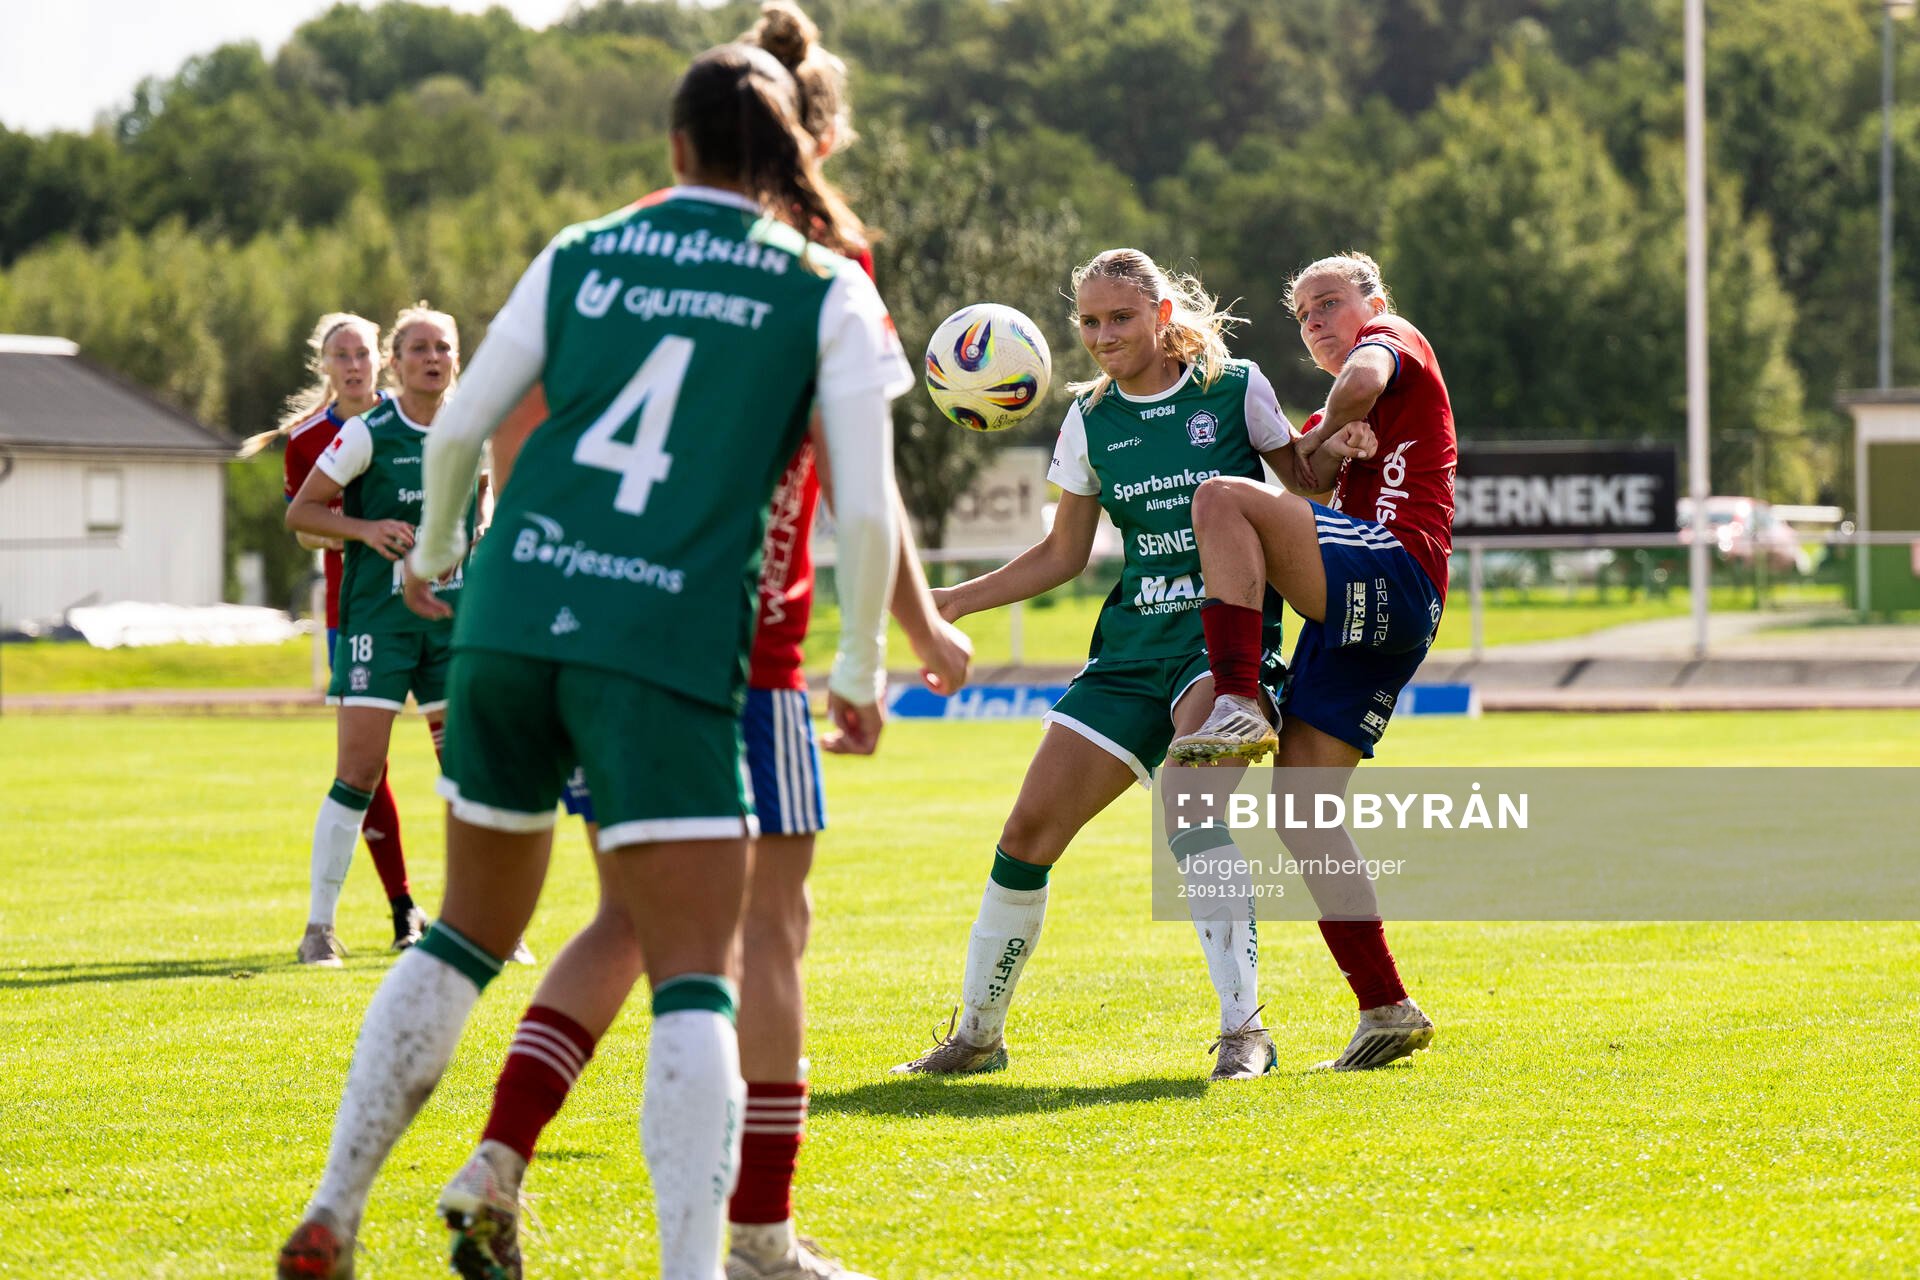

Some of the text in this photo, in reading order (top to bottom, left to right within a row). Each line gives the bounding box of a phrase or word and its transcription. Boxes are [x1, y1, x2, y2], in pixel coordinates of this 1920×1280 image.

[572, 334, 696, 517] 4
[1140, 405, 1176, 420] TIFOSI
[1107, 438, 1134, 452] CRAFT
[1114, 468, 1221, 501] Sparbanken
[1146, 494, 1190, 512] Alingsås
[1452, 474, 1656, 527] SERNEKE
[1137, 528, 1197, 557] SERNE
[1155, 600, 1204, 615] STORMAR
[1349, 592, 1366, 642] PEAB
[348, 633, 373, 663] 18
[998, 937, 1025, 983] CRAFT
